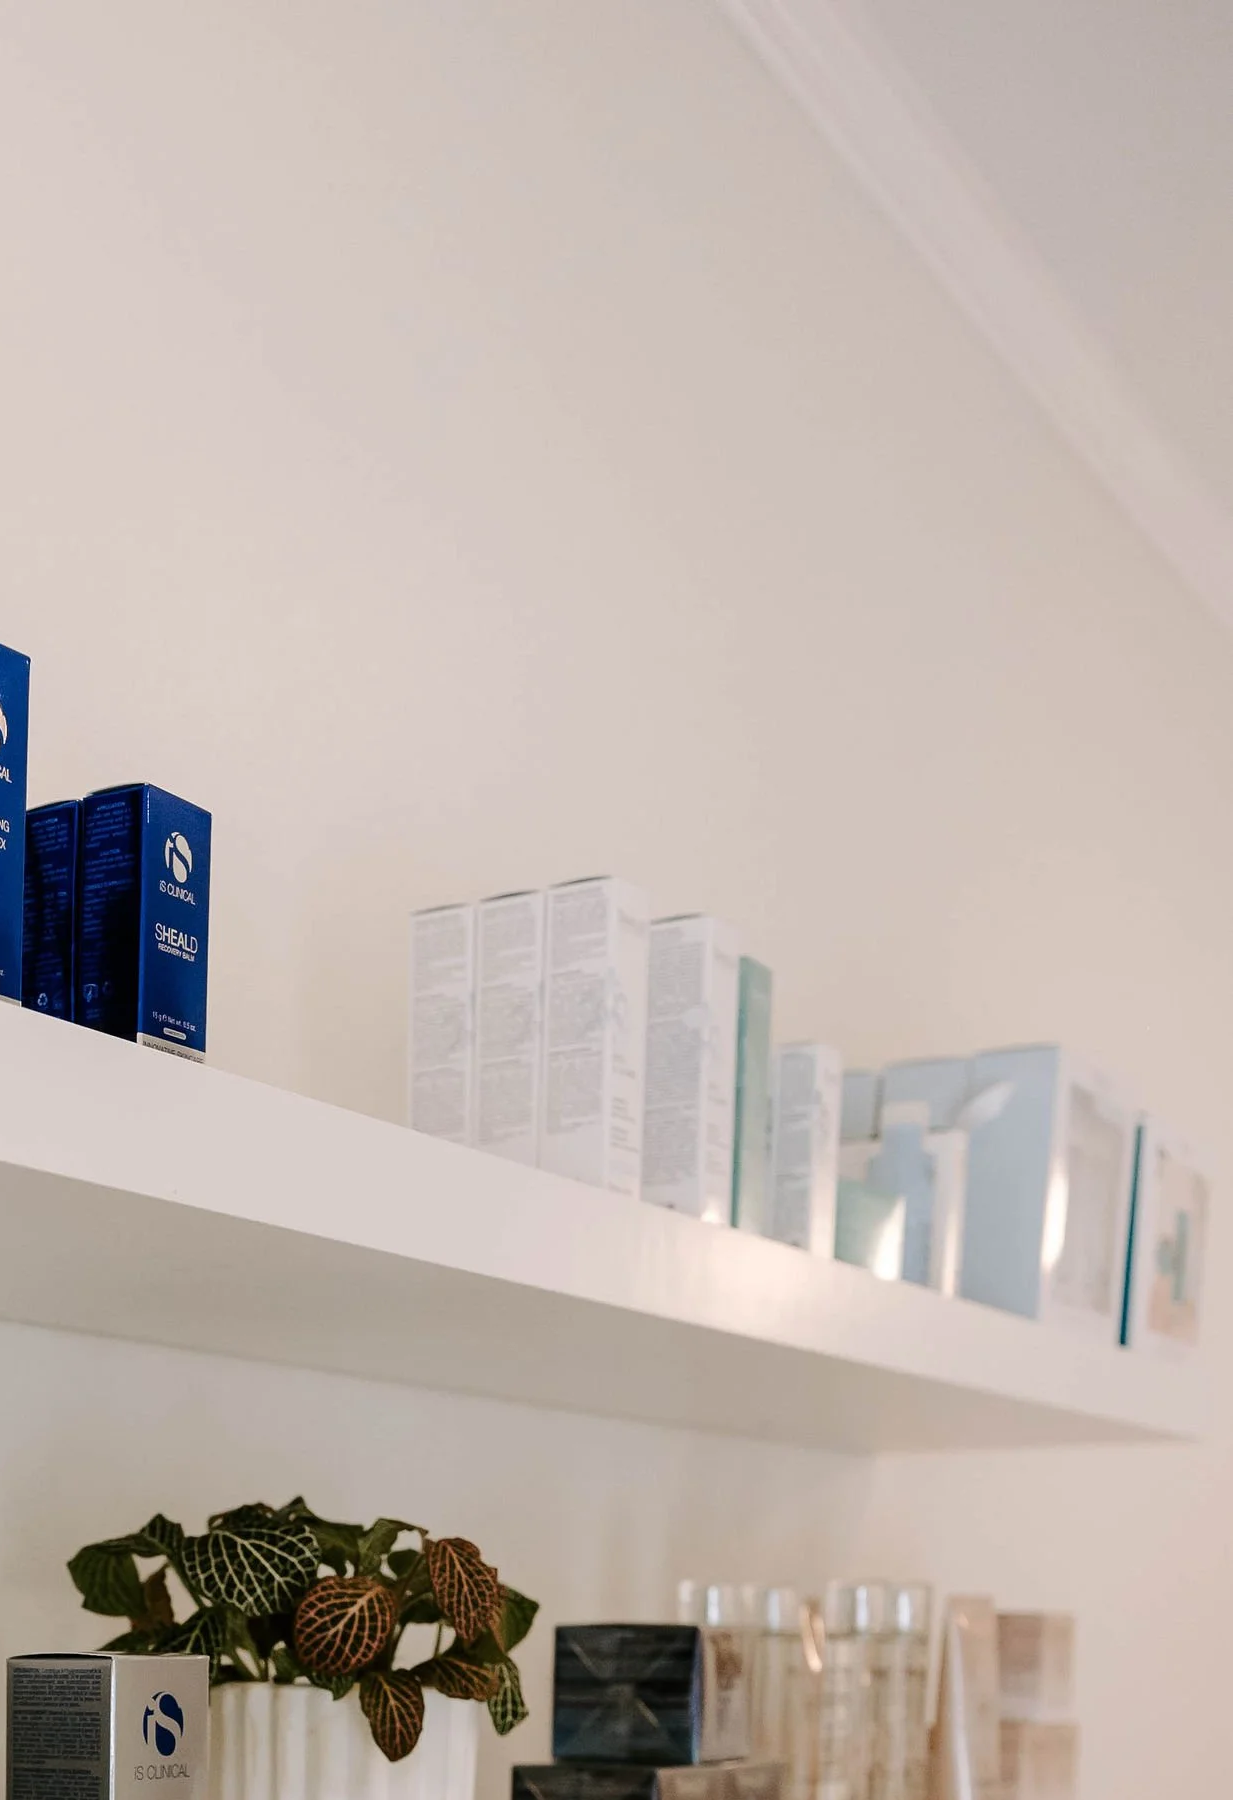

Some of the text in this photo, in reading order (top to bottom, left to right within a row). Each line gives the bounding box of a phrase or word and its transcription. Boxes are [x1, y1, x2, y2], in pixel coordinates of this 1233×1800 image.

[166, 882, 197, 906] CLINICAL
[154, 922, 199, 955] SHEALD
[157, 942, 196, 962] RECOVERY BALM
[146, 1762, 191, 1780] CLINICAL
